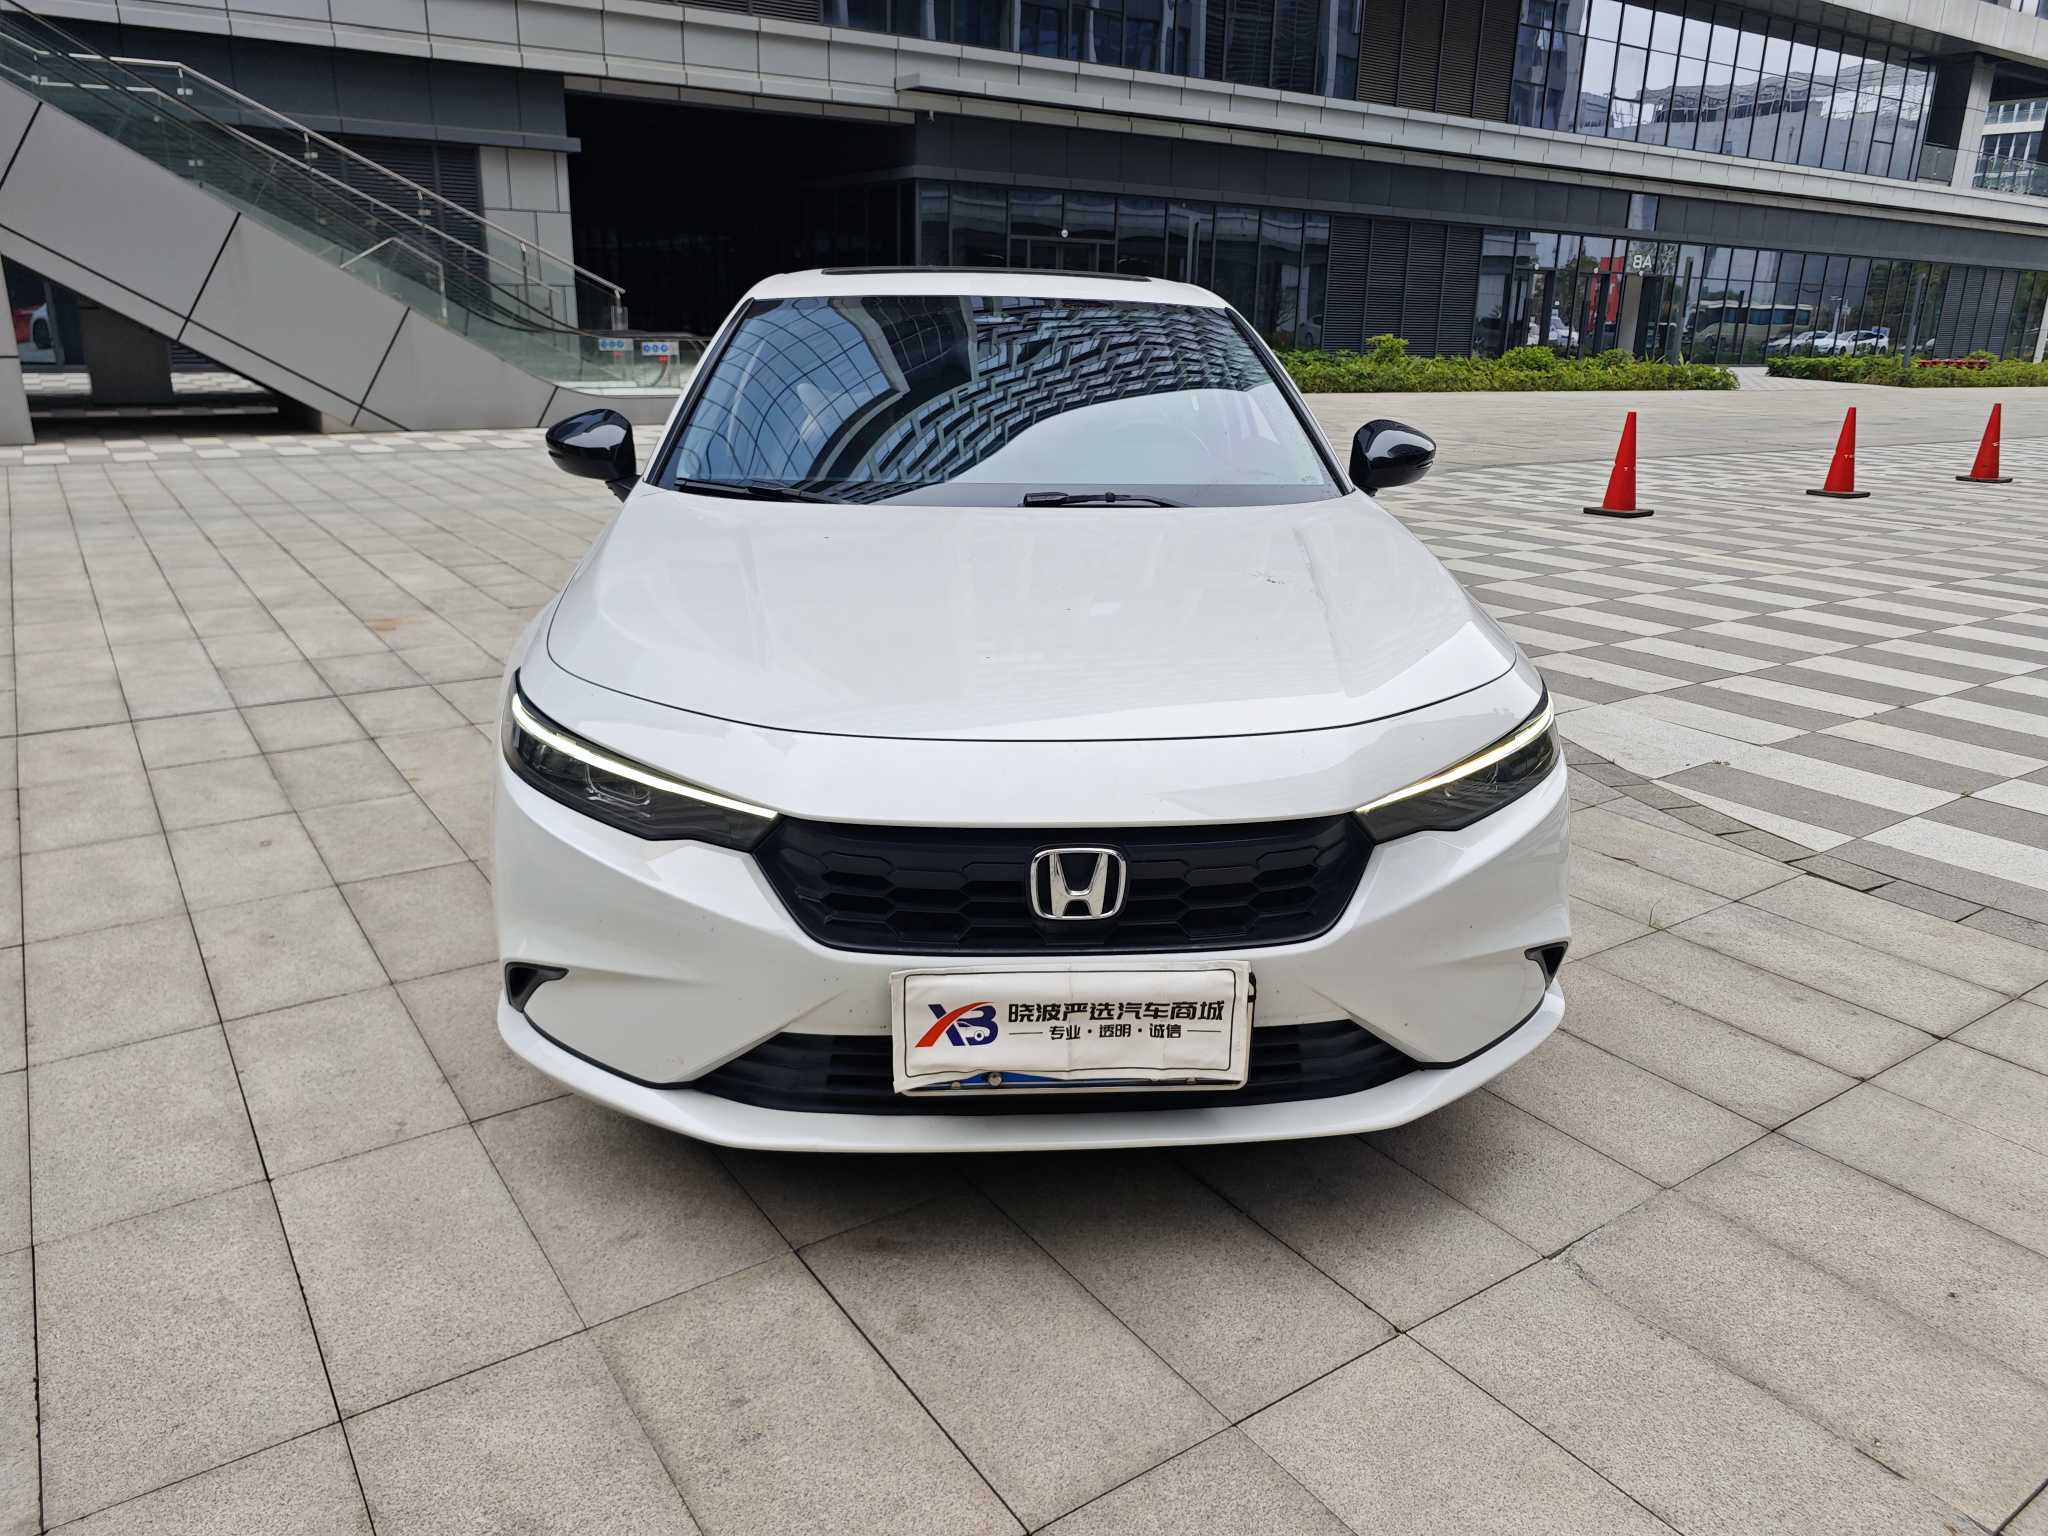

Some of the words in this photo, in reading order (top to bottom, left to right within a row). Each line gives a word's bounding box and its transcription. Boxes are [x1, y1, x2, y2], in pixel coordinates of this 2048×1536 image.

[1633, 254, 1652, 269] 8A
[1007, 1000, 1225, 1023] 晓波严选汽车商城
